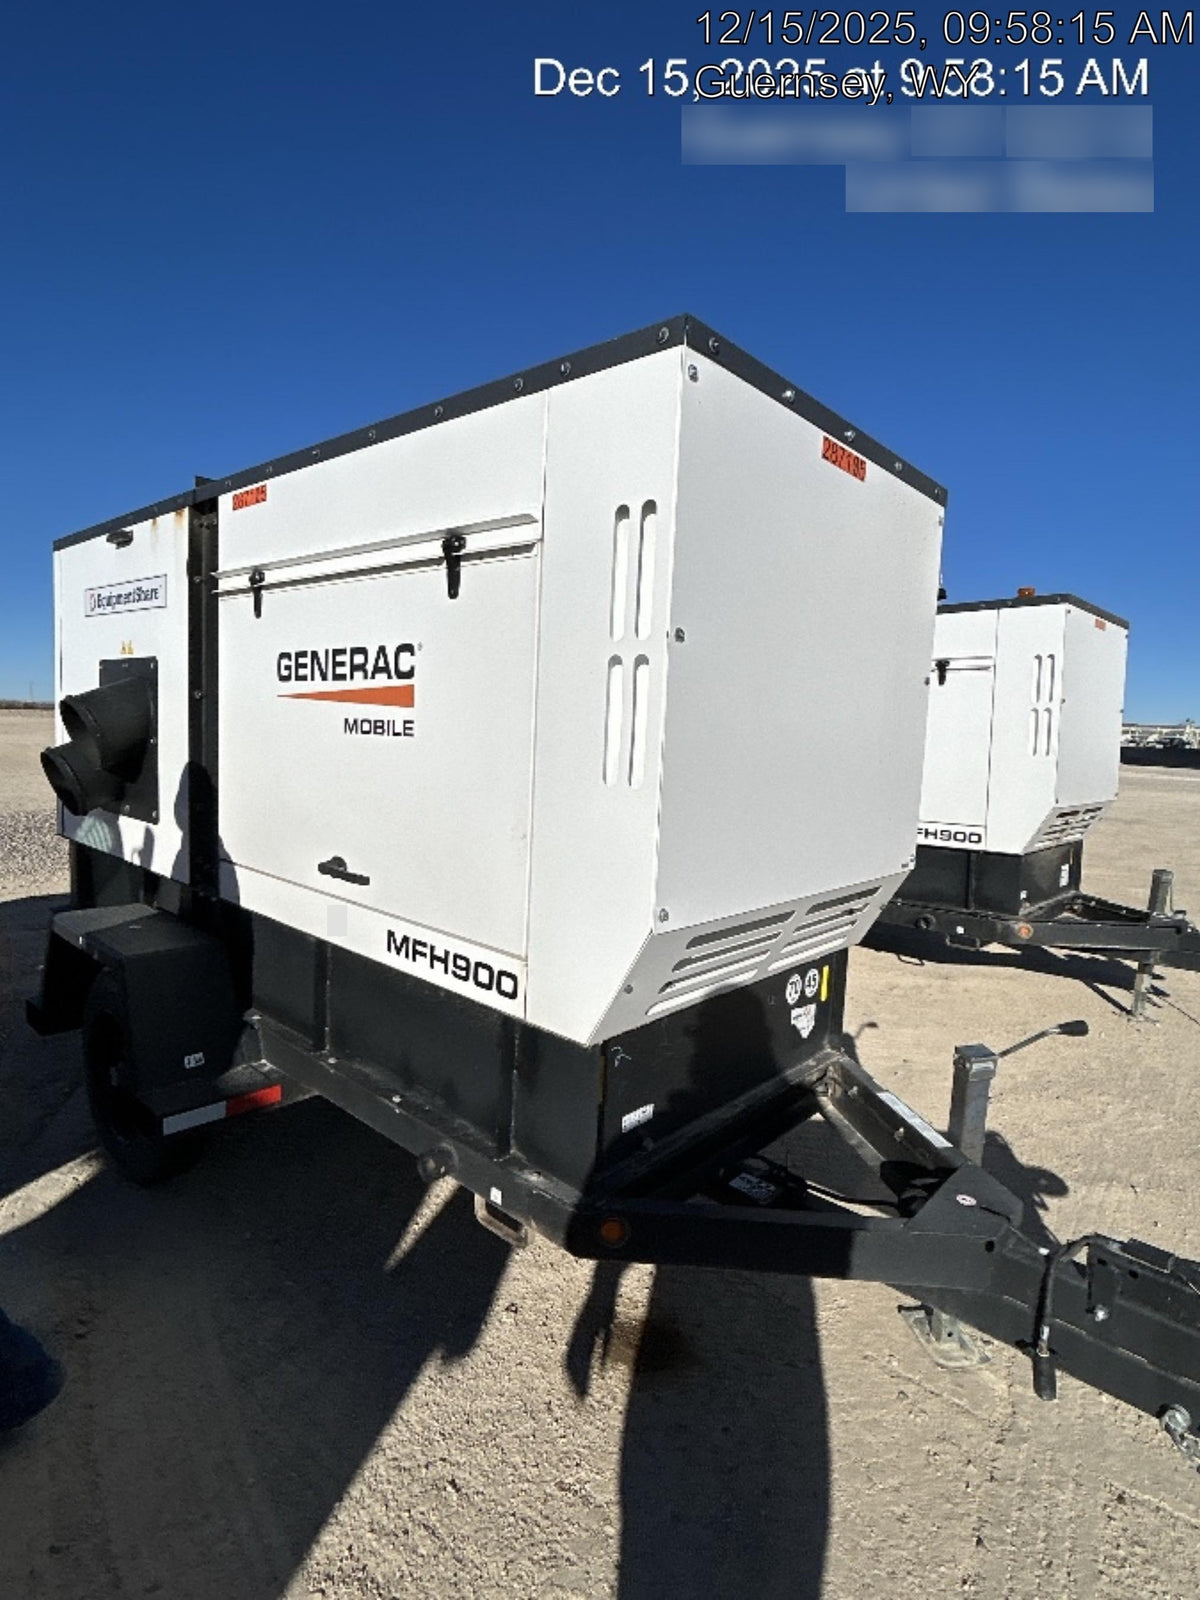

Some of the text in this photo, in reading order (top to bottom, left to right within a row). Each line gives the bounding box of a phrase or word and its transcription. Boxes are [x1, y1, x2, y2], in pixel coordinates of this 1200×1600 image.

[276, 642, 415, 683] GENERAC
[343, 717, 415, 737] MOBILE
[916, 827, 983, 844] FH900
[386, 928, 519, 1001] MFH900
